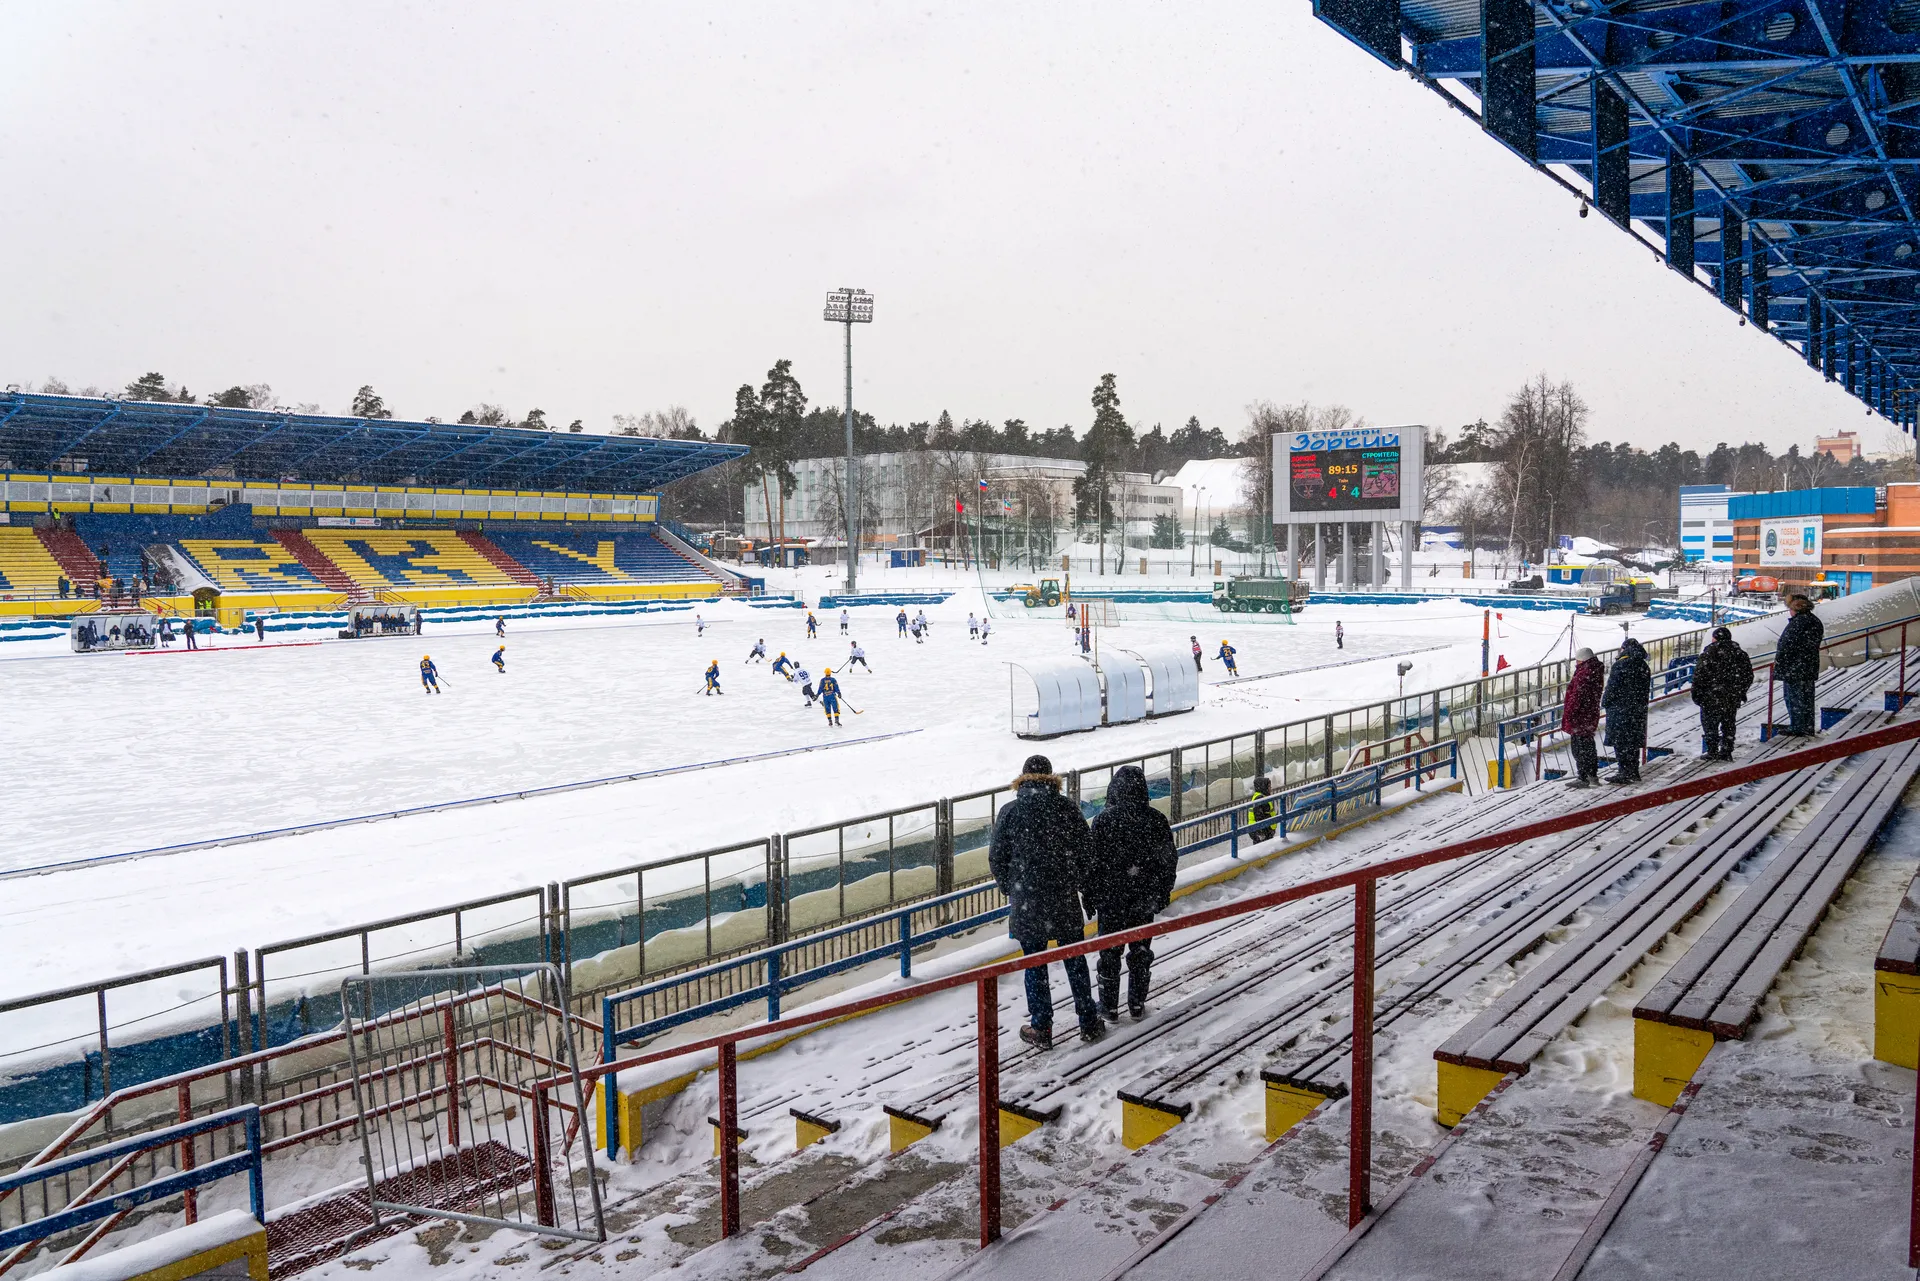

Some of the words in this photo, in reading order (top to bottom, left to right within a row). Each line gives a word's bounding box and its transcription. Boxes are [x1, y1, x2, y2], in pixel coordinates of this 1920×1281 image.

[1290, 433, 1399, 452] Зоркий
[1362, 451, 1399, 459] СТРОИТЕЛЬ
[1328, 464, 1358, 475] 89:15
[1328, 487, 1337, 498] 4
[1350, 486, 1360, 498] 4
[799, 671, 808, 680] 99
[824, 683, 834, 691] 41
